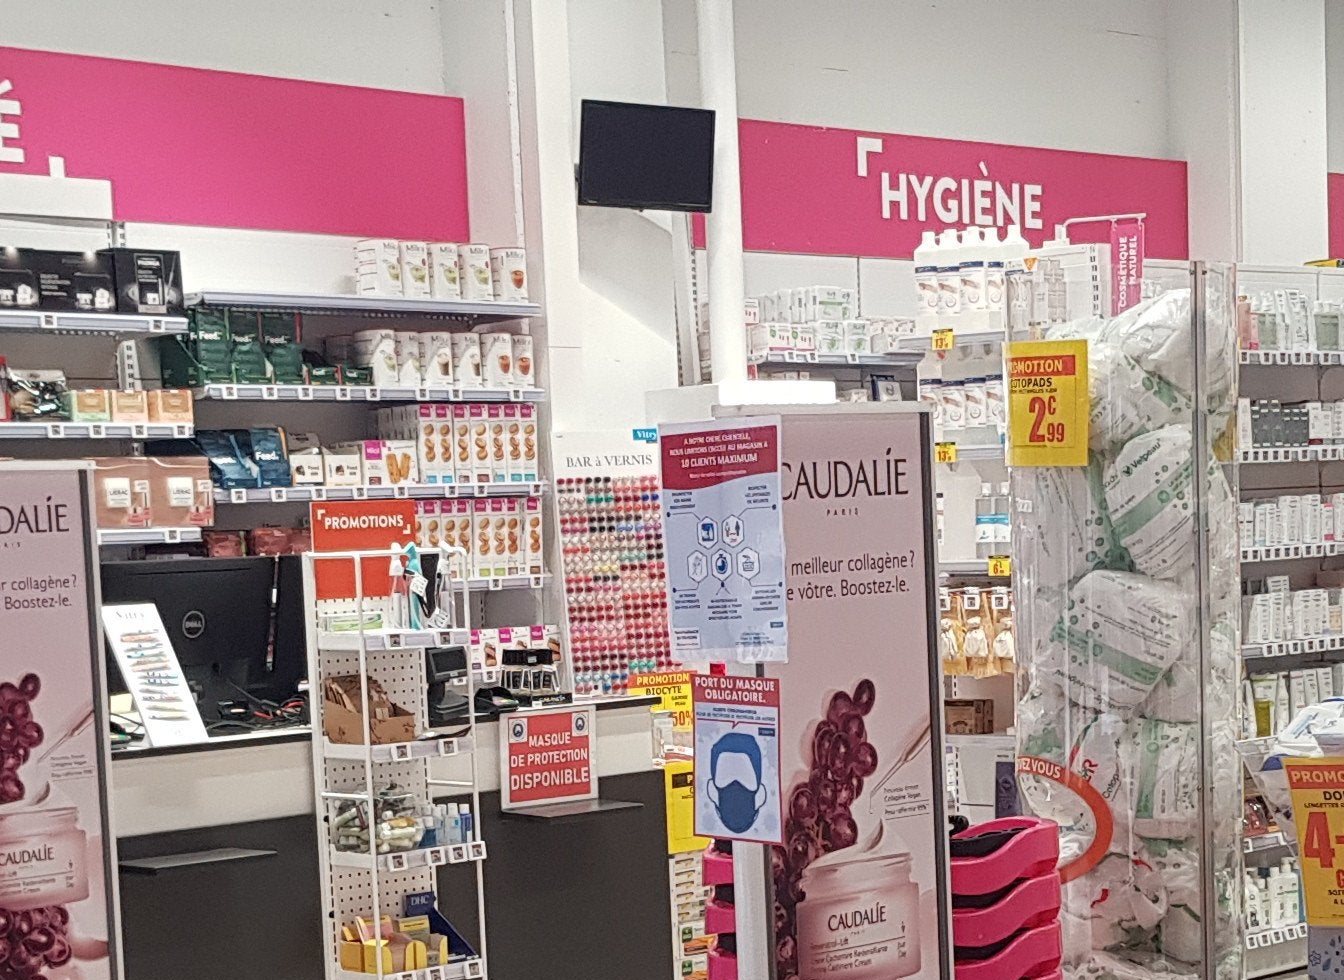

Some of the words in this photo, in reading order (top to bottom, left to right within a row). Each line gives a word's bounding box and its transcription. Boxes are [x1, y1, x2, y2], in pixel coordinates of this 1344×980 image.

[880, 160, 1044, 229] HYGIÈNE
[1129, 235, 1138, 285] NATUREL
[1118, 236, 1129, 307] COSMÉTIQUE
[1029, 396, 1046, 442] 2
[566, 456, 592, 467] BAR
[595, 457, 602, 466] à
[604, 454, 653, 466] VERNIS
[826, 508, 859, 516] PARIS
[324, 514, 404, 530] PROMOTIONS
[791, 553, 843, 576] meilleur
[847, 550, 915, 574] collagène?
[11, 574, 77, 592] collagène?
[798, 582, 837, 600] vôtre.
[840, 575, 910, 597] Boostez-le.
[4, 593, 72, 610] Boostez-le.
[637, 674, 690, 686] PROMOTION
[695, 677, 718, 688] PORT
[721, 678, 733, 688] DU
[735, 679, 775, 691] MASQUE
[528, 732, 571, 747] MASQUE
[511, 755, 524, 767] DE
[527, 748, 588, 765] PROTECTION
[1031, 760, 1061, 778] VOUS
[511, 769, 589, 790] DISPONIBLE
[828, 902, 886, 931] CAUDALÍE
